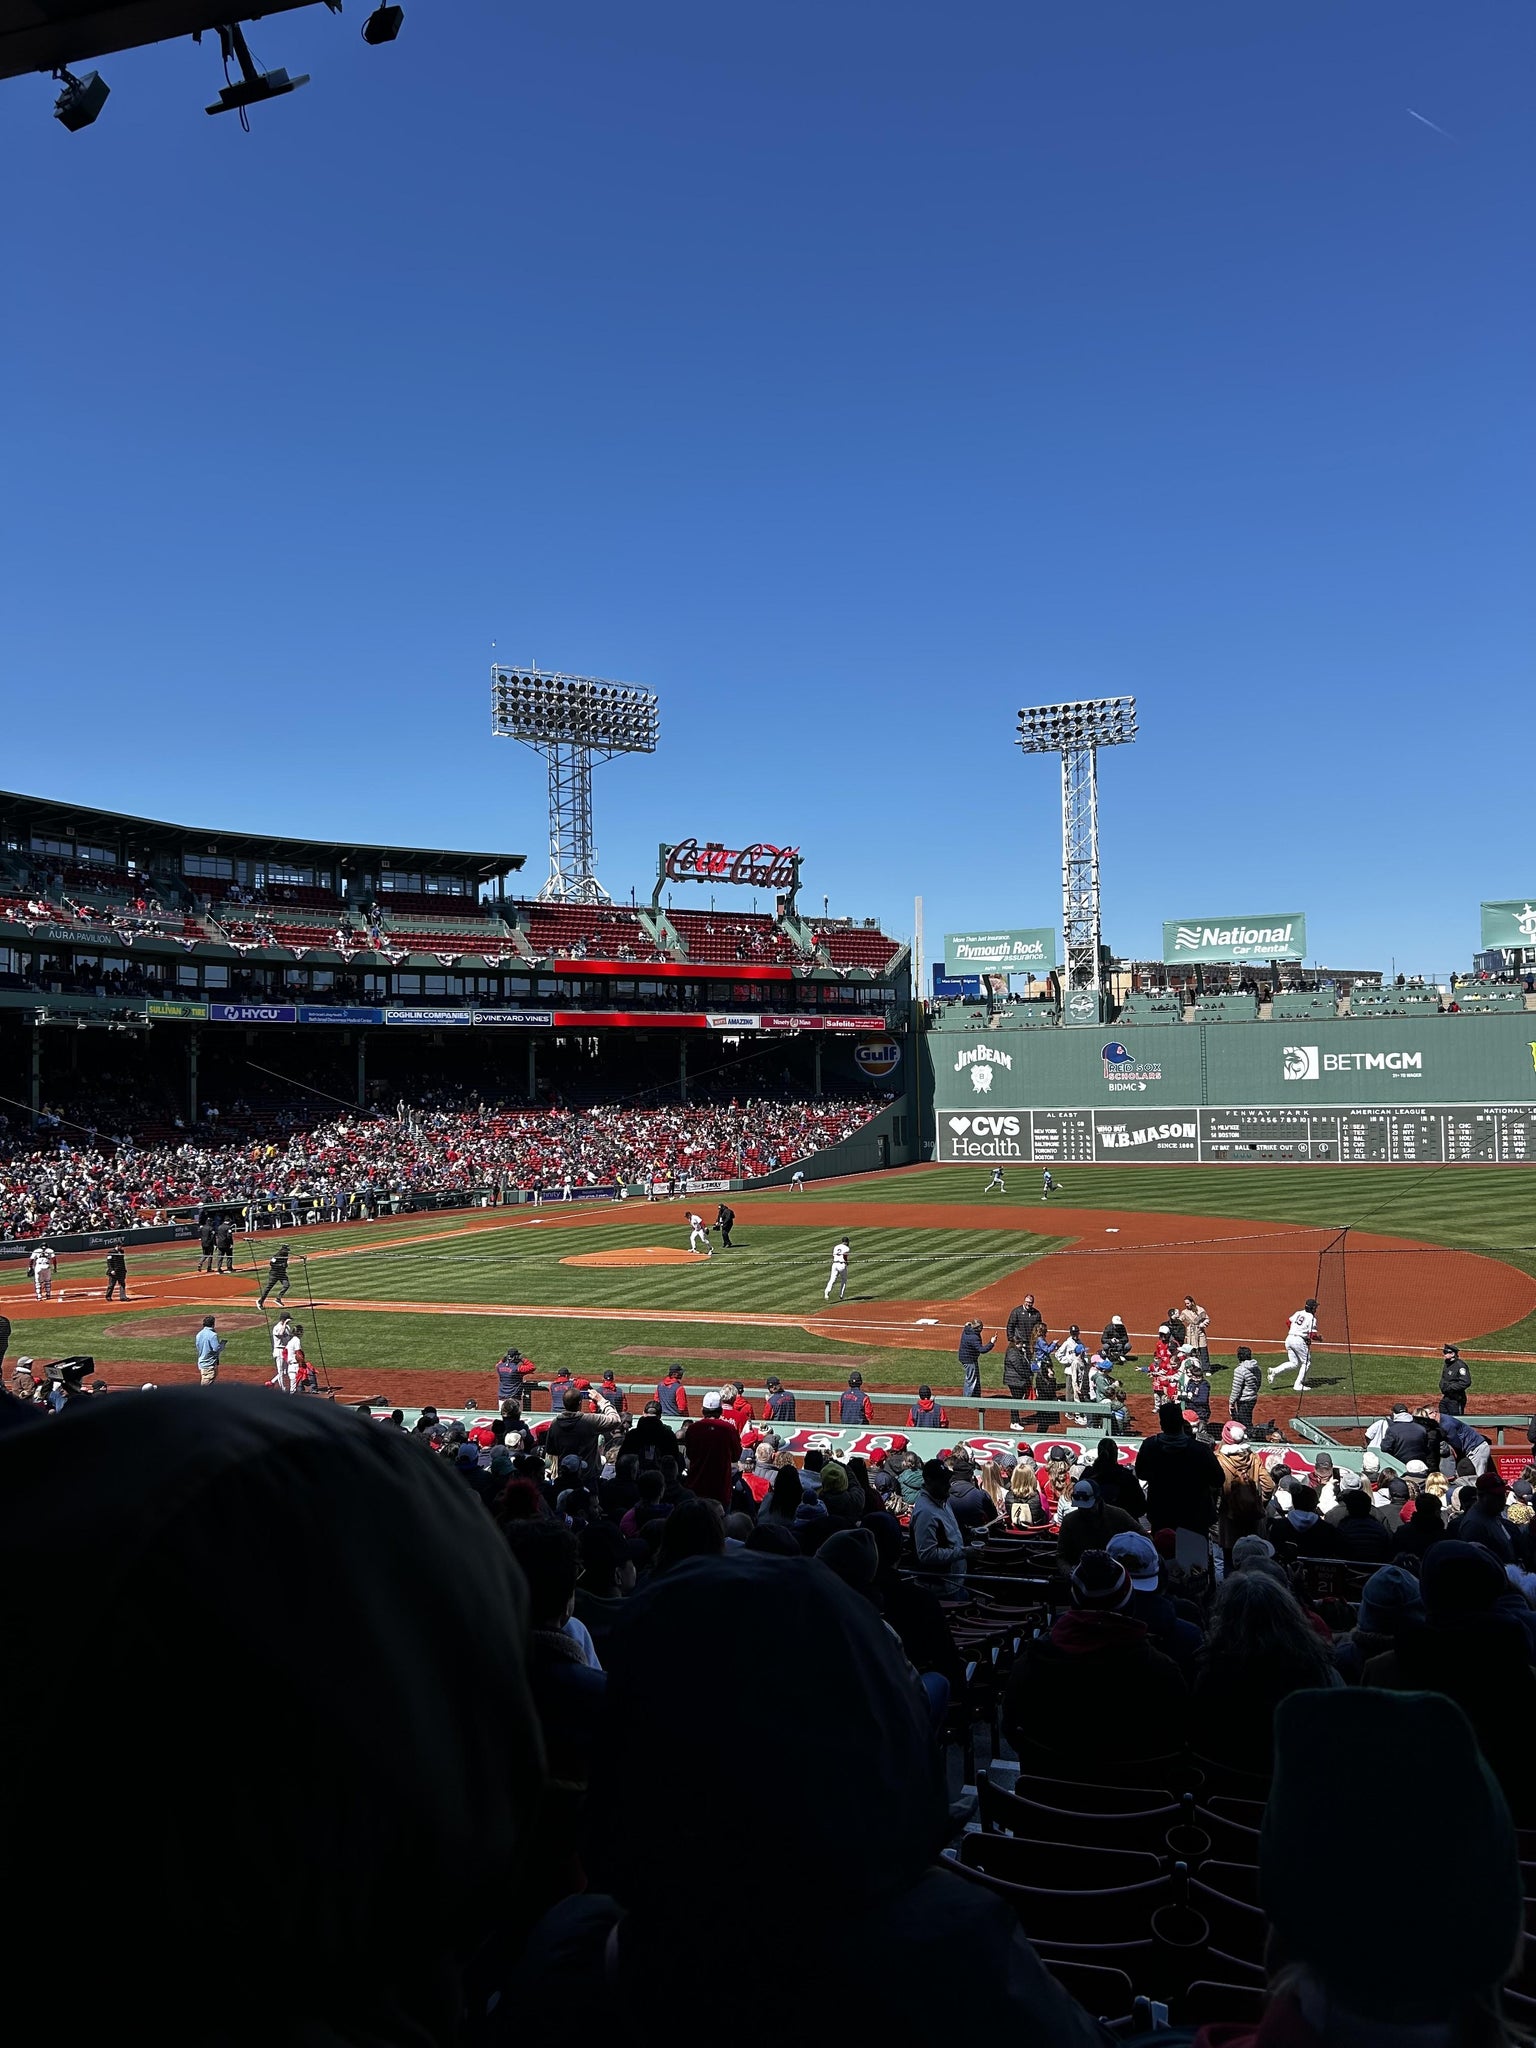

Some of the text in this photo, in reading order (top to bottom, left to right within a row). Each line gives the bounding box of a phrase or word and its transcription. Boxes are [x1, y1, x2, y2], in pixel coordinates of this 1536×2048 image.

[667, 838, 800, 888] Coca-Cola
[49, 931, 112, 943] AURA PAVILION
[957, 940, 1043, 958] Plymouth Rock
[1232, 944, 1288, 955] Car Rental
[149, 1006, 206, 1016] SULLIVAN TIRE
[242, 1009, 277, 1019] HYCU
[856, 1047, 898, 1061] Gulf
[954, 1044, 1013, 1072] JIM BEAM
[1108, 1063, 1162, 1072] RED SOX
[1323, 1052, 1422, 1071] BETMGM
[1108, 1072, 1162, 1080] SCHOLARS
[1108, 1083, 1137, 1091] BIDMC
[971, 1116, 1020, 1136] CVS
[1096, 1124, 1126, 1133] WHO BUT
[1101, 1123, 1196, 1148] W.B.MASON
[951, 1137, 1022, 1157] Health
[837, 1248, 842, 1256] 2
